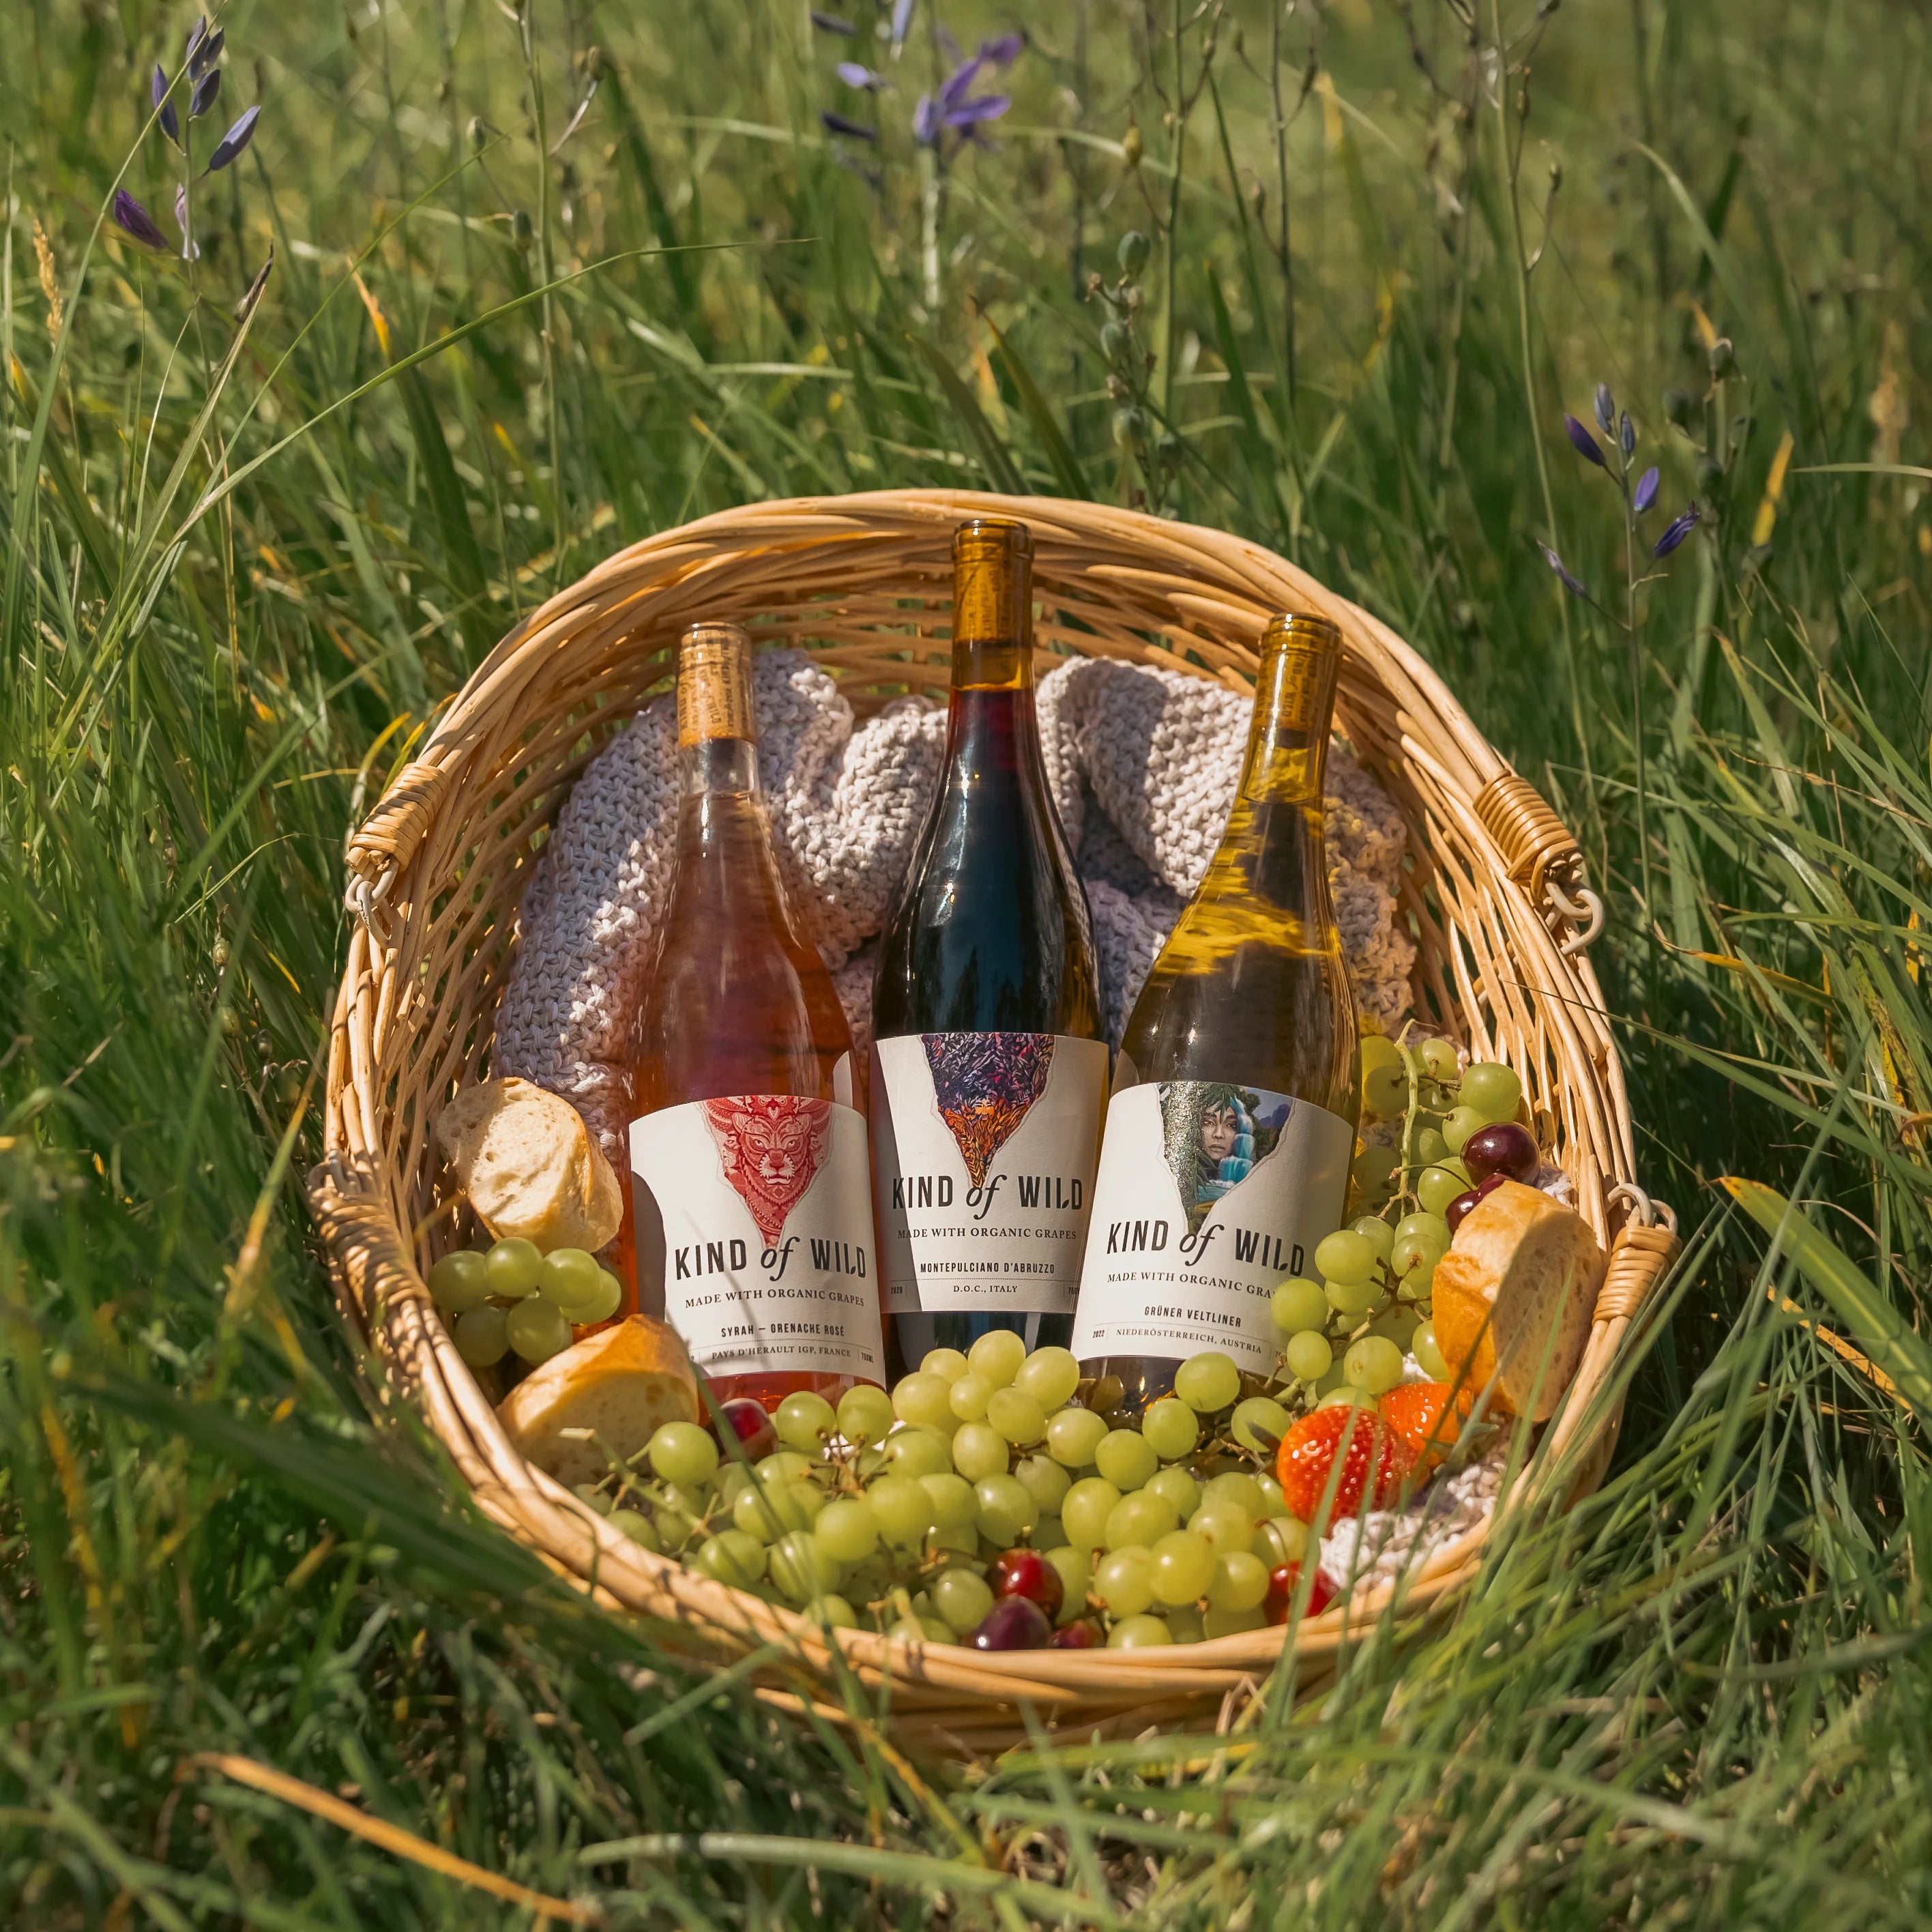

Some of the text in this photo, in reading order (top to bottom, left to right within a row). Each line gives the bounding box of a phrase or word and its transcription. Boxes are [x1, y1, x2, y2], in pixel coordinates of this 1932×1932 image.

[892, 1174, 1083, 1220] KIND of WILD
[897, 1227, 1077, 1240] MADE WITH ORGANIC GRAPES
[675, 1235, 867, 1282] KIND of WILD
[1107, 1220, 1304, 1277] KIND of WILD
[920, 1262, 1055, 1274] MONTEPULCIANO D'ABRUZZO
[953, 1285, 1018, 1294] D.O.C., ITALY
[1107, 1271, 1275, 1299] MADE WITH ORGANIC GRA
[685, 1288, 865, 1308] MADE WITH ORGANIC GRAPES
[1144, 1305, 1242, 1328] GRÜNER VELTLINER
[721, 1323, 755, 1338] SYRAH
[770, 1323, 822, 1335] GRENACHE
[824, 1323, 845, 1337] ROSÉ
[1092, 1330, 1105, 1338] 2022
[1116, 1327, 1262, 1354] NIEDERÖSTERREICH, AUSTRIA
[712, 1349, 735, 1360] PAYS
[797, 1345, 817, 1356] IGP,
[819, 1346, 851, 1358] FRANCE
